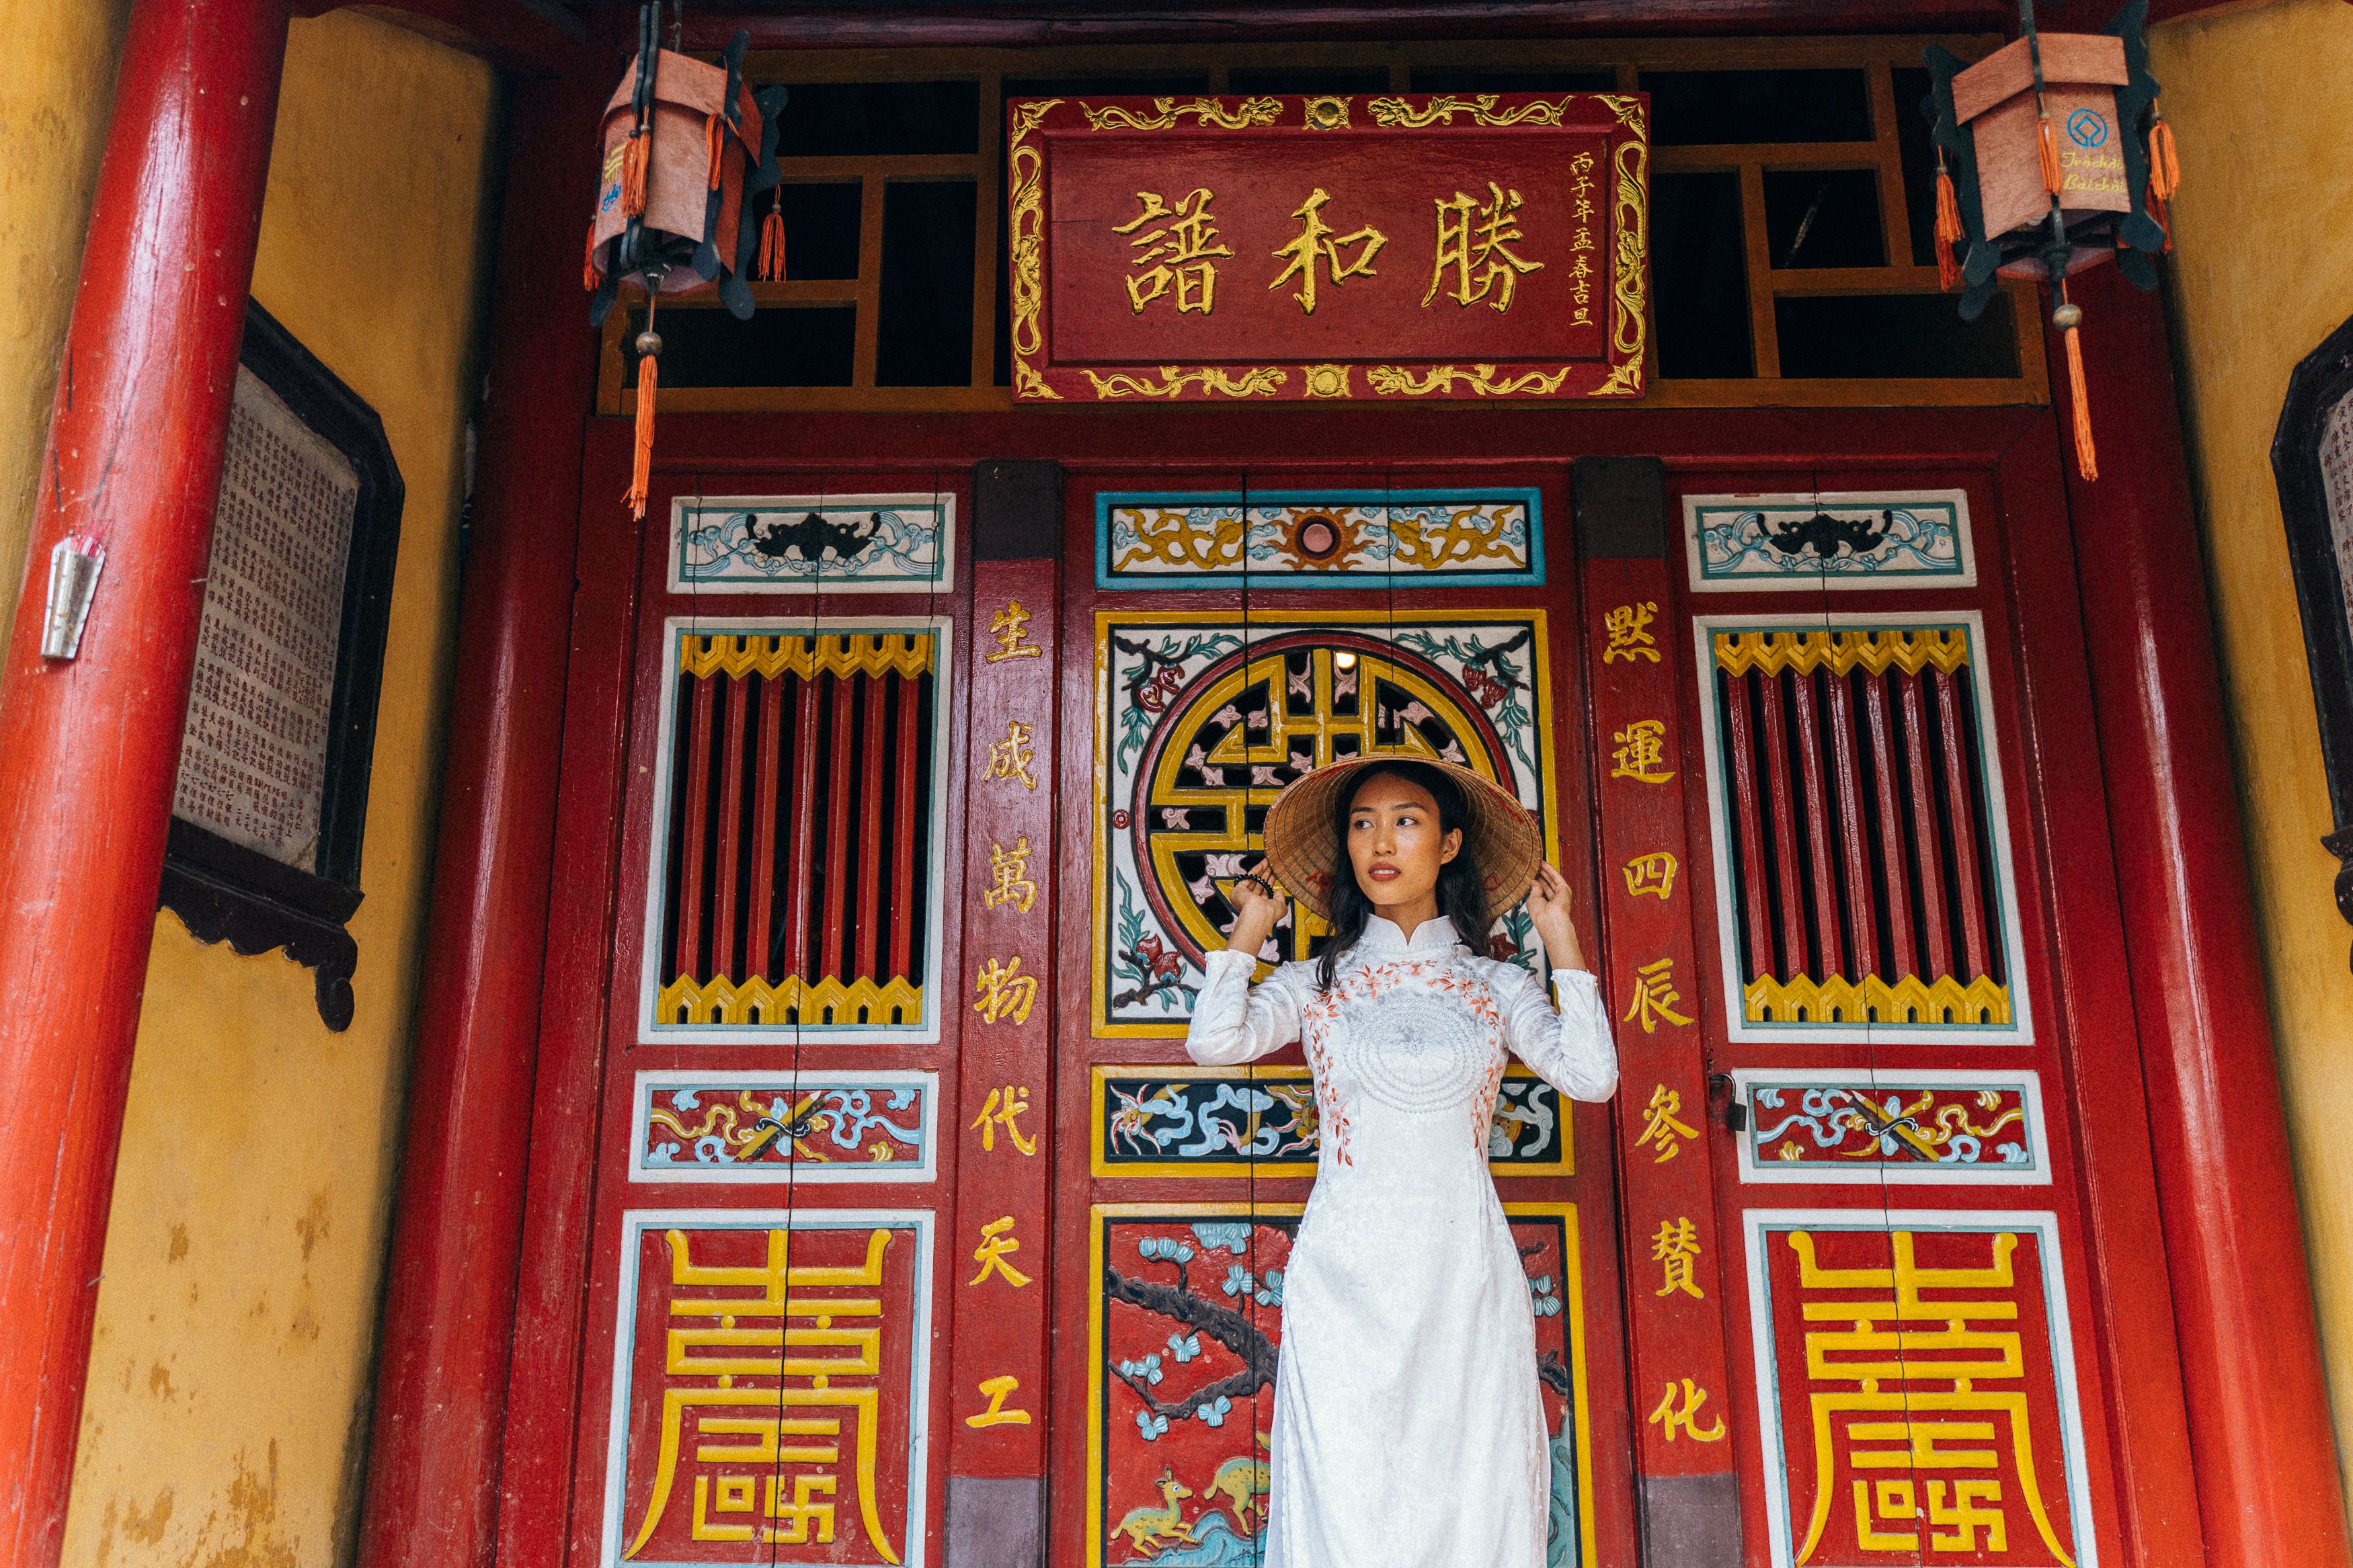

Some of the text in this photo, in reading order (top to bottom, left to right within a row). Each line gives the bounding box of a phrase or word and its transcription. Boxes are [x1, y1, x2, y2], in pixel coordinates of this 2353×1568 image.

[1569, 151, 1595, 326] 丙子年孟春吉旦
[965, 602, 1042, 1428] 生成萬物代天工
